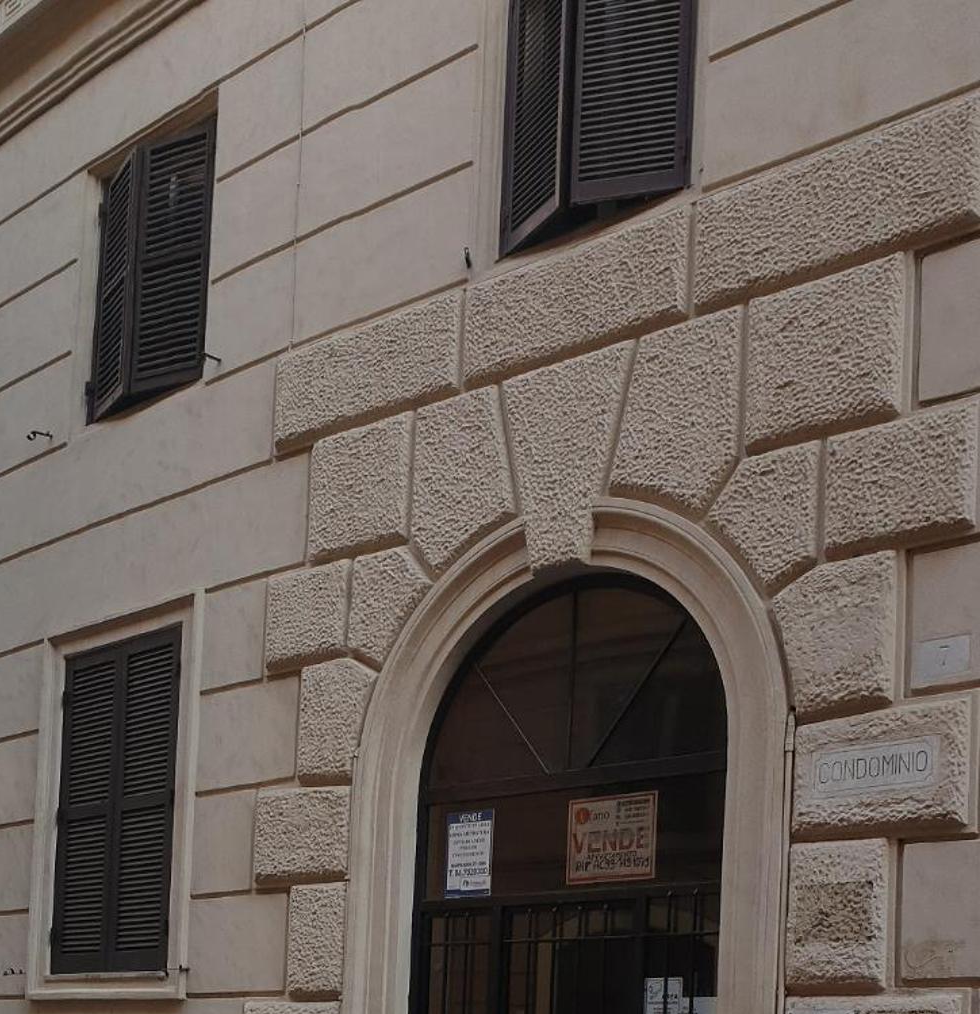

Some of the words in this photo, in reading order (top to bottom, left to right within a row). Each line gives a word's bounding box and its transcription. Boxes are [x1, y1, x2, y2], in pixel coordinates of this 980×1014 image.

[818, 749, 929, 784] CONDOMINIO
[459, 812, 483, 823] VENDE
[571, 826, 648, 854] VENDE
